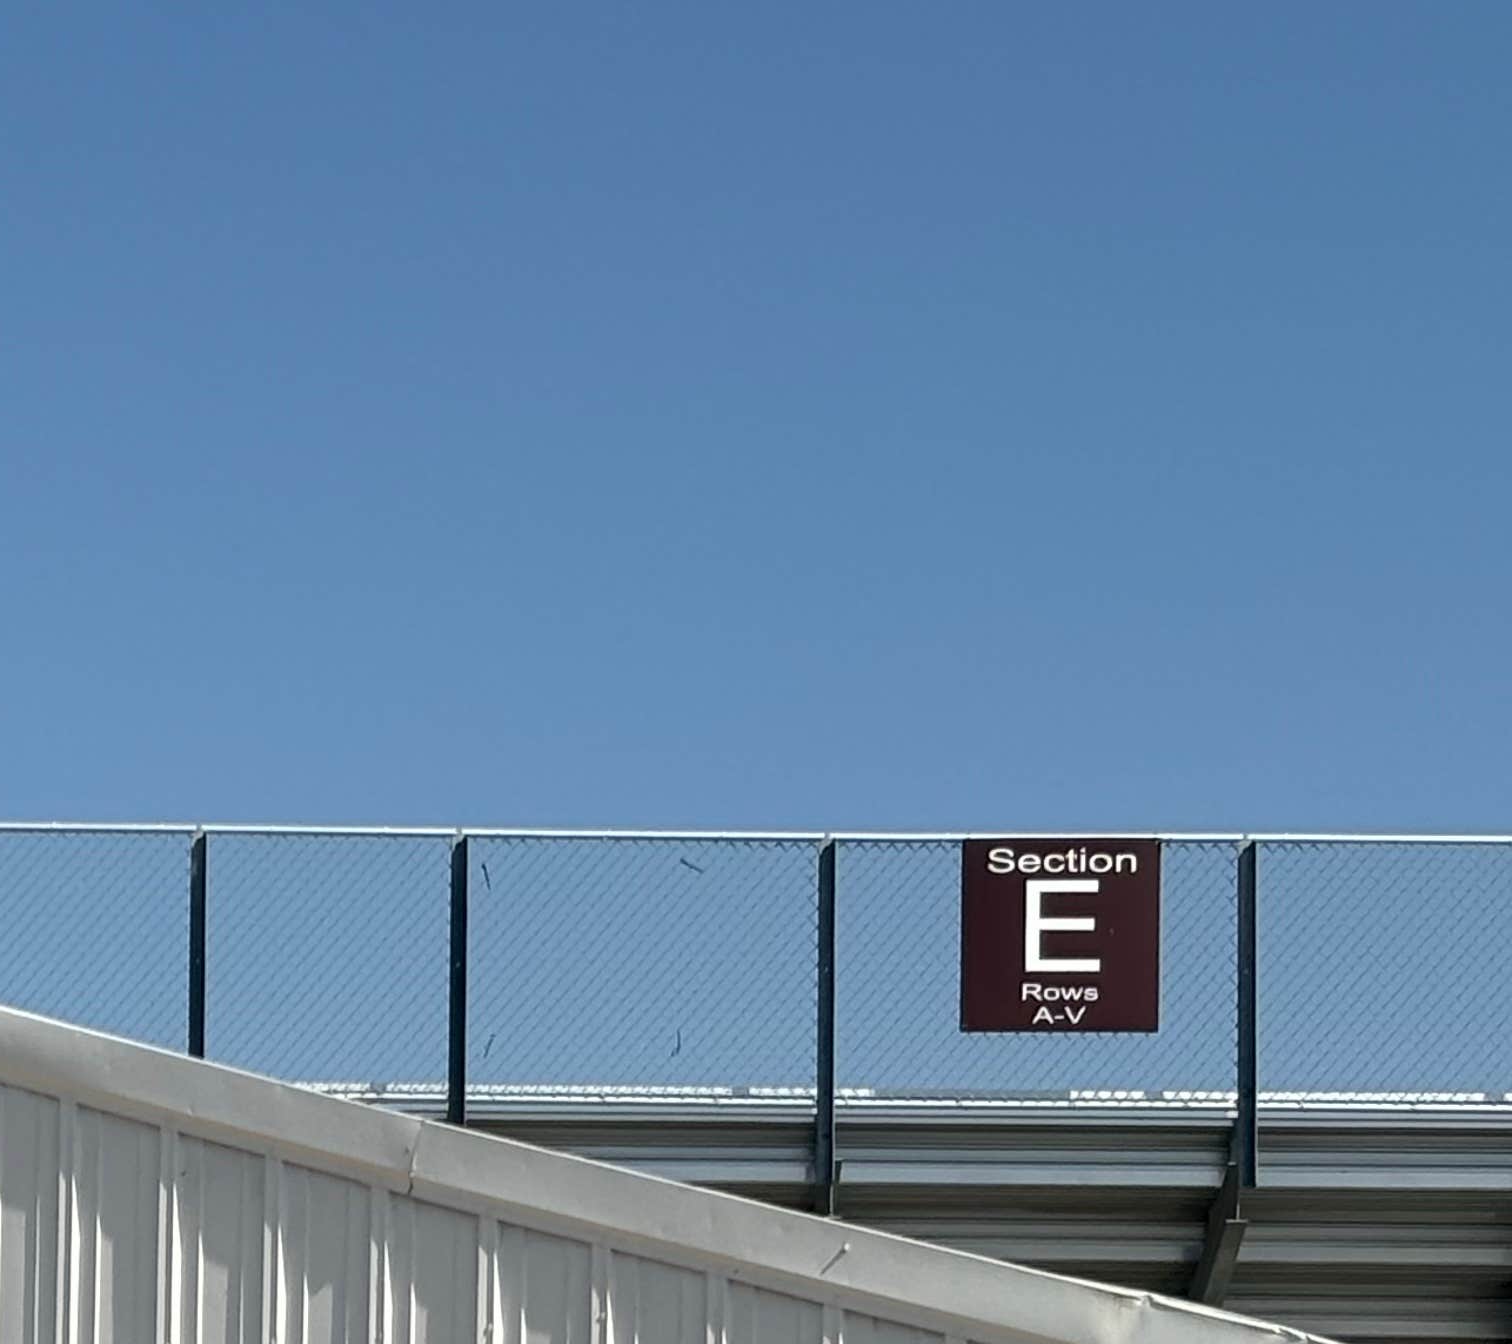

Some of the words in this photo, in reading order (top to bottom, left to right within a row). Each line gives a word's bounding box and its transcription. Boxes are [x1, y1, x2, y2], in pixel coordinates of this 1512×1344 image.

[987, 847, 1137, 873] Section
[1024, 879, 1101, 972] E
[1021, 983, 1099, 1001] Rows
[1032, 1006, 1086, 1024] A-V
